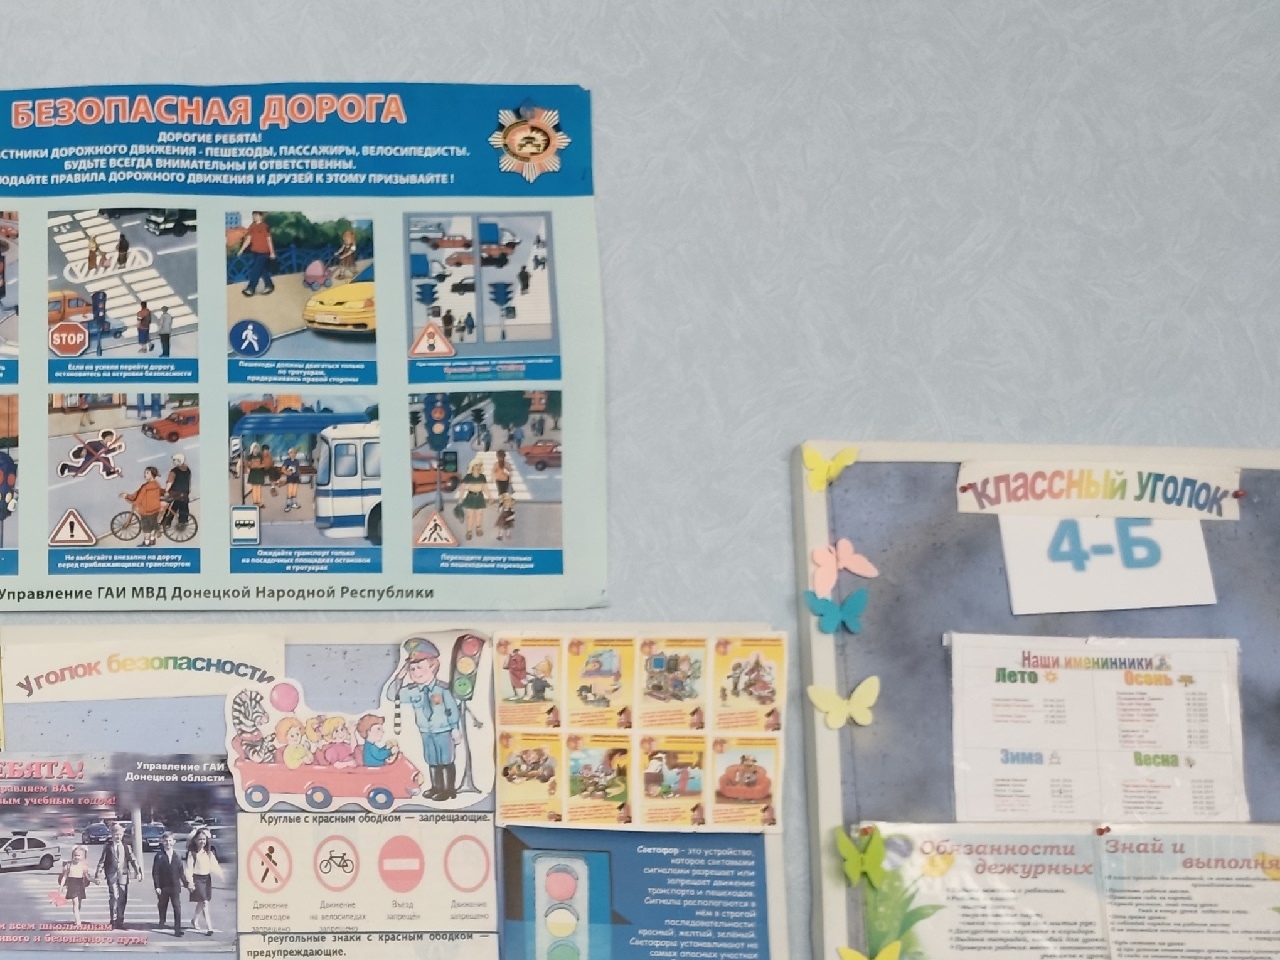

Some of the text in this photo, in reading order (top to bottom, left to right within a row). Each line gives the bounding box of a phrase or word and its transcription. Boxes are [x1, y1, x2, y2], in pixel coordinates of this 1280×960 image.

[11, 93, 407, 130] БЕЗОПАСНАЯ ДОРОГА
[157, 131, 262, 143] ДОРОГИЕ РЕБЯТА!
[51, 145, 127, 159] ДОРОЖНОГО
[129, 145, 196, 157] ДВИЖЕНИЯ
[205, 146, 278, 158] ПЕШЕХОДЫ,
[279, 146, 359, 157] ПАССАЖИРЫ,
[362, 146, 470, 158] ВЕЛОСИПЕДИСТЫ.
[64, 157, 356, 171] БУДЬТЕ ВСЕГДА ВНИМАТЕЛЬНЫ И ОТВЕТСТВЕННЫ.
[51, 172, 105, 184] ПРАВИЛА
[109, 172, 184, 183] ДОРОЖНОГО
[187, 173, 254, 185] ДВИЖЕНИЯ
[257, 174, 266, 184] И
[268, 173, 313, 185] ДРУЗЕЙ
[316, 173, 323, 183] К
[326, 173, 365, 184] ЭТОМУ
[369, 173, 447, 184] ПРИЗЫВАЙТЕ
[53, 332, 84, 345] STOP
[1047, 517, 1161, 572] 4-Б
[98, 587, 126, 599] ГАИ
[131, 587, 167, 601] МВД
[171, 586, 251, 600] Донецкой
[255, 586, 335, 600] Народной
[341, 586, 435, 601] Республики
[1021, 650, 1154, 670] Наши именинники
[16, 653, 275, 697] Уголок безопасности
[995, 668, 1173, 686] Лето Осень
[1000, 749, 1179, 768] Зима Весна
[137, 762, 225, 771] Управление ГАИ
[125, 772, 225, 783] Донецкой области
[52, 785, 75, 793] ВАС
[24, 797, 74, 806] учебным
[260, 813, 301, 826] Круглые
[312, 815, 356, 825] красным
[358, 813, 401, 824] ободком
[419, 813, 491, 825] запрещающие.
[920, 840, 1076, 857] Обязанности
[1105, 838, 1186, 854] Знай и
[975, 861, 1094, 881] дежурных
[261, 933, 326, 945] Треугольные
[332, 933, 362, 942] знаки
[378, 933, 423, 943] красным
[428, 932, 474, 942] ободком
[247, 948, 347, 959] предупреждающие.
